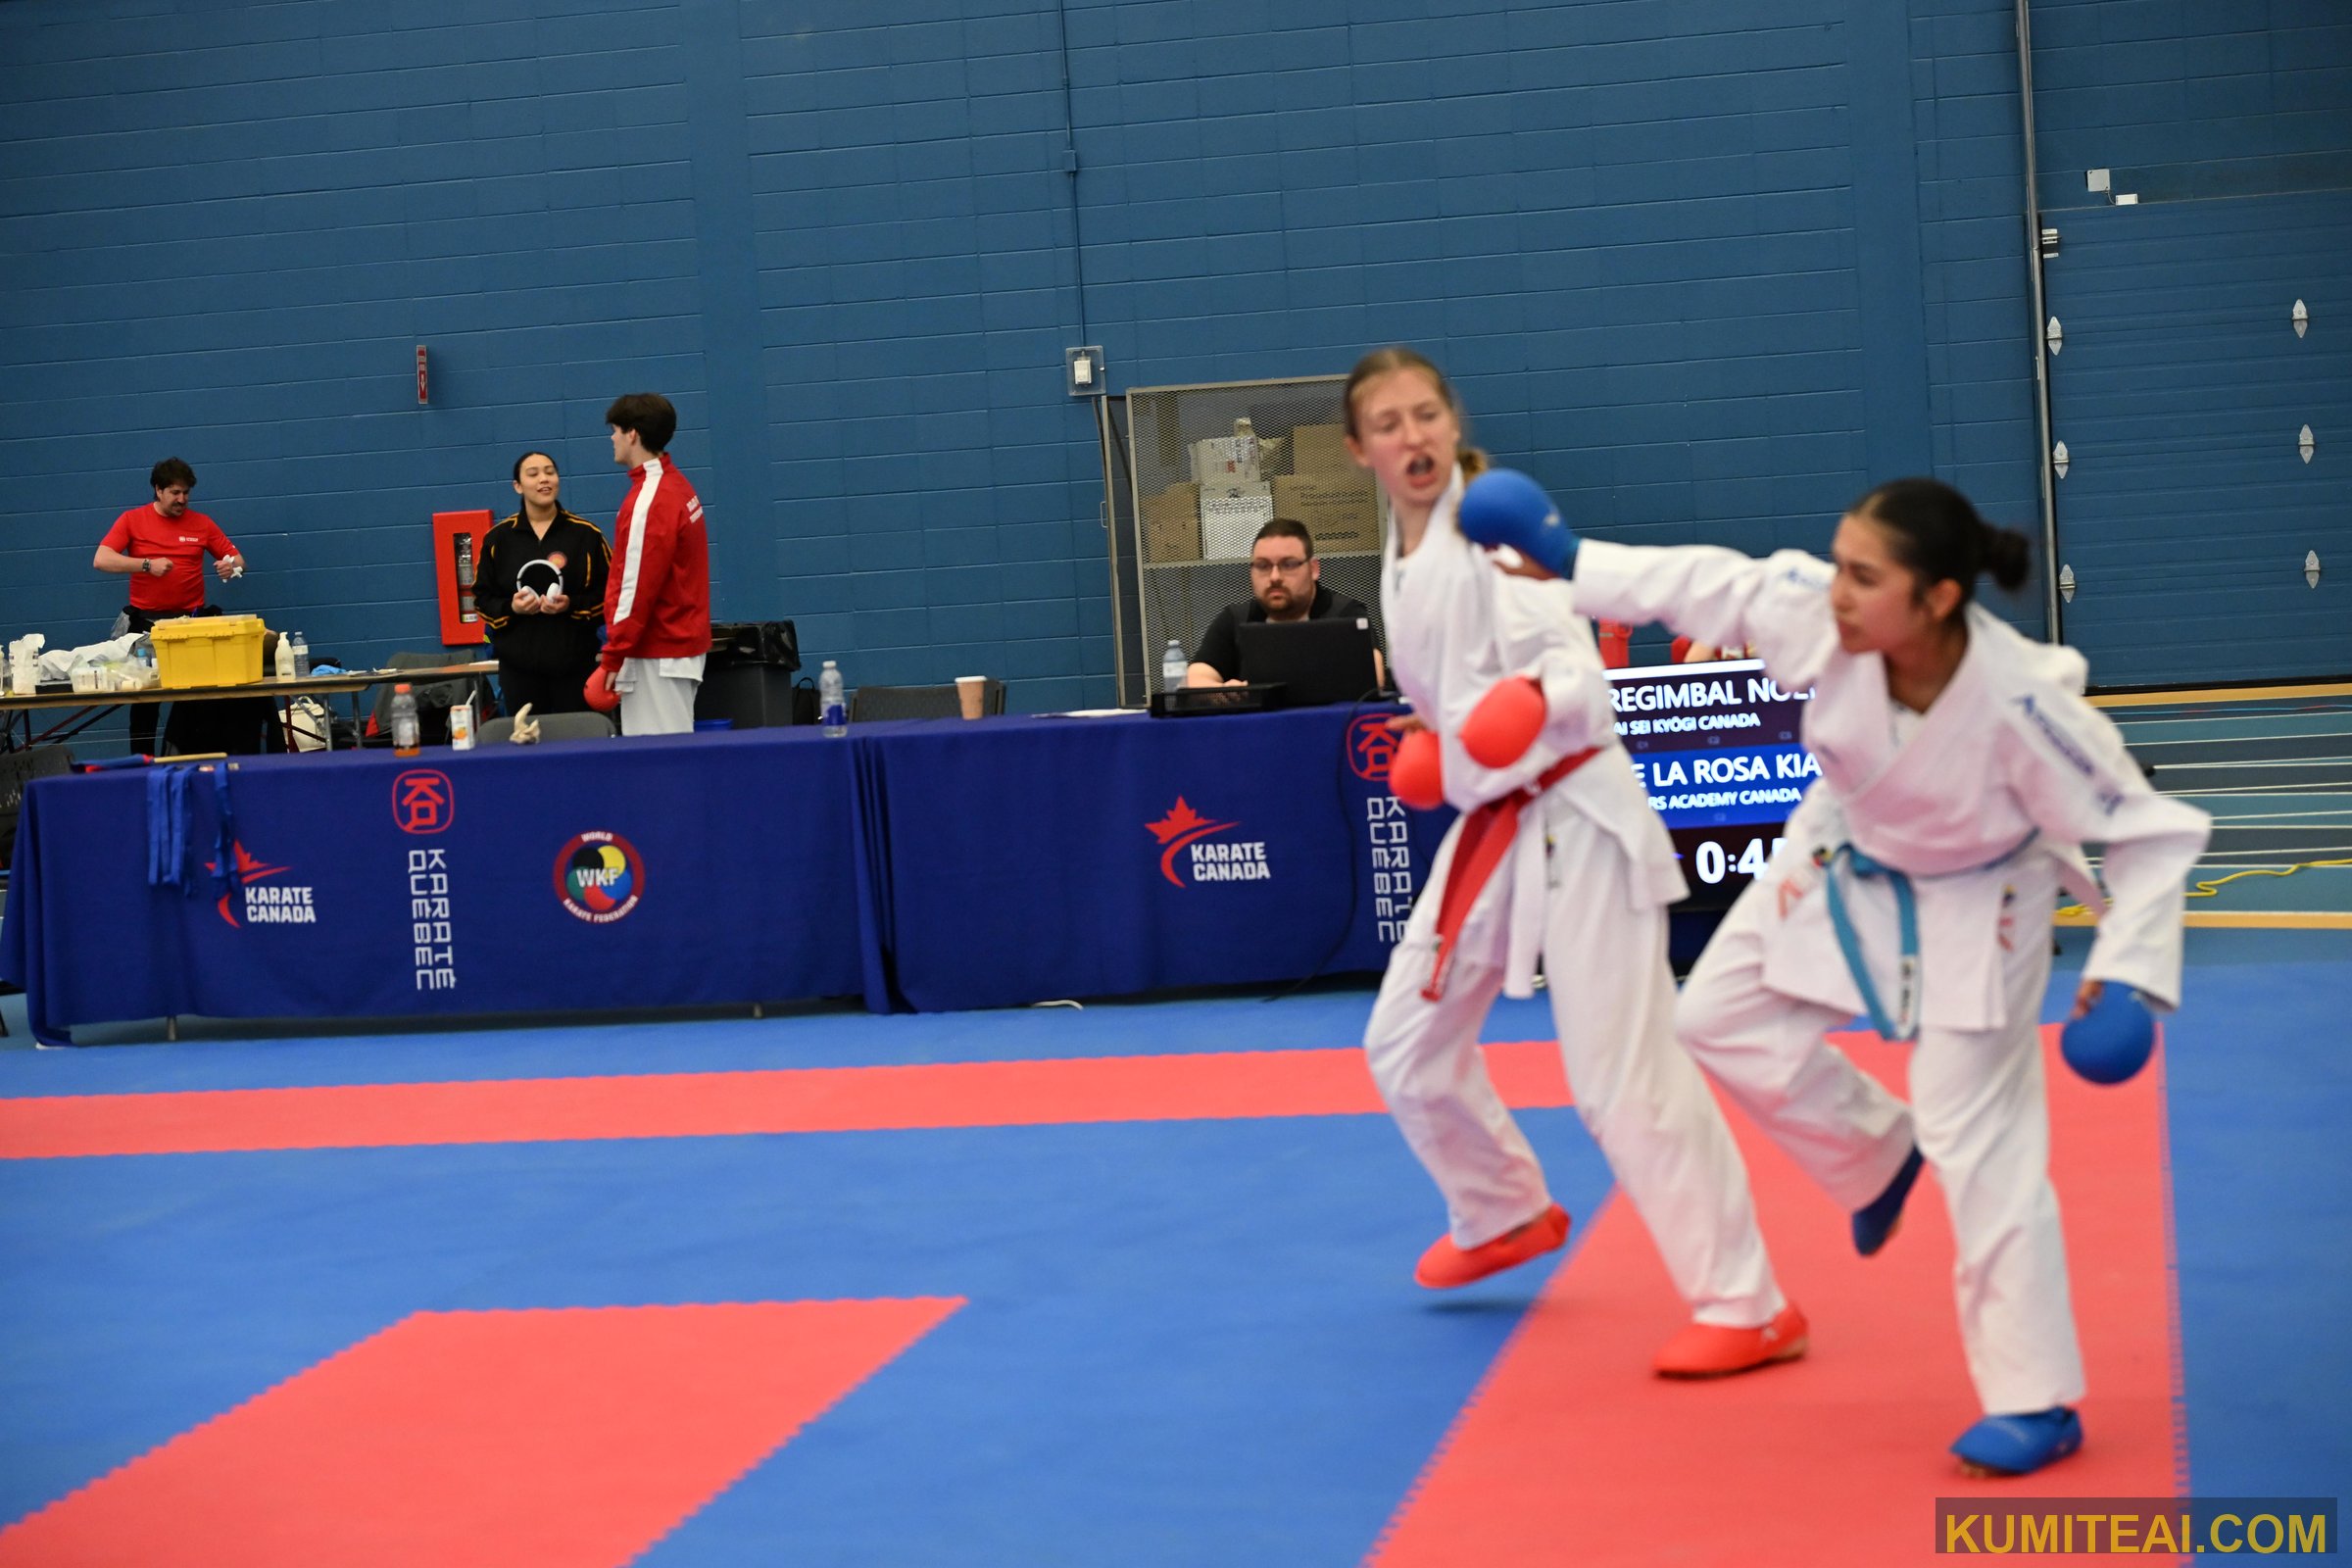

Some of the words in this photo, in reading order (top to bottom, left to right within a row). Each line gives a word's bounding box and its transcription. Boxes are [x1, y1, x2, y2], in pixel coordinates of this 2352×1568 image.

[1607, 680, 1742, 712] REGIMBAL
[1629, 719, 1651, 735] SEI
[1697, 712, 1761, 730] CANADA
[1652, 760, 1688, 787] LA
[1693, 756, 1771, 784] ROSA
[1668, 791, 1738, 809] ACADEMY
[1740, 787, 1802, 805] CANADA
[580, 830, 613, 842] WORLD
[1191, 841, 1266, 862] KARATE
[576, 867, 618, 887] WKF
[1193, 860, 1271, 881] CANADA
[245, 886, 314, 905] KARATE
[246, 905, 317, 923] CANADA
